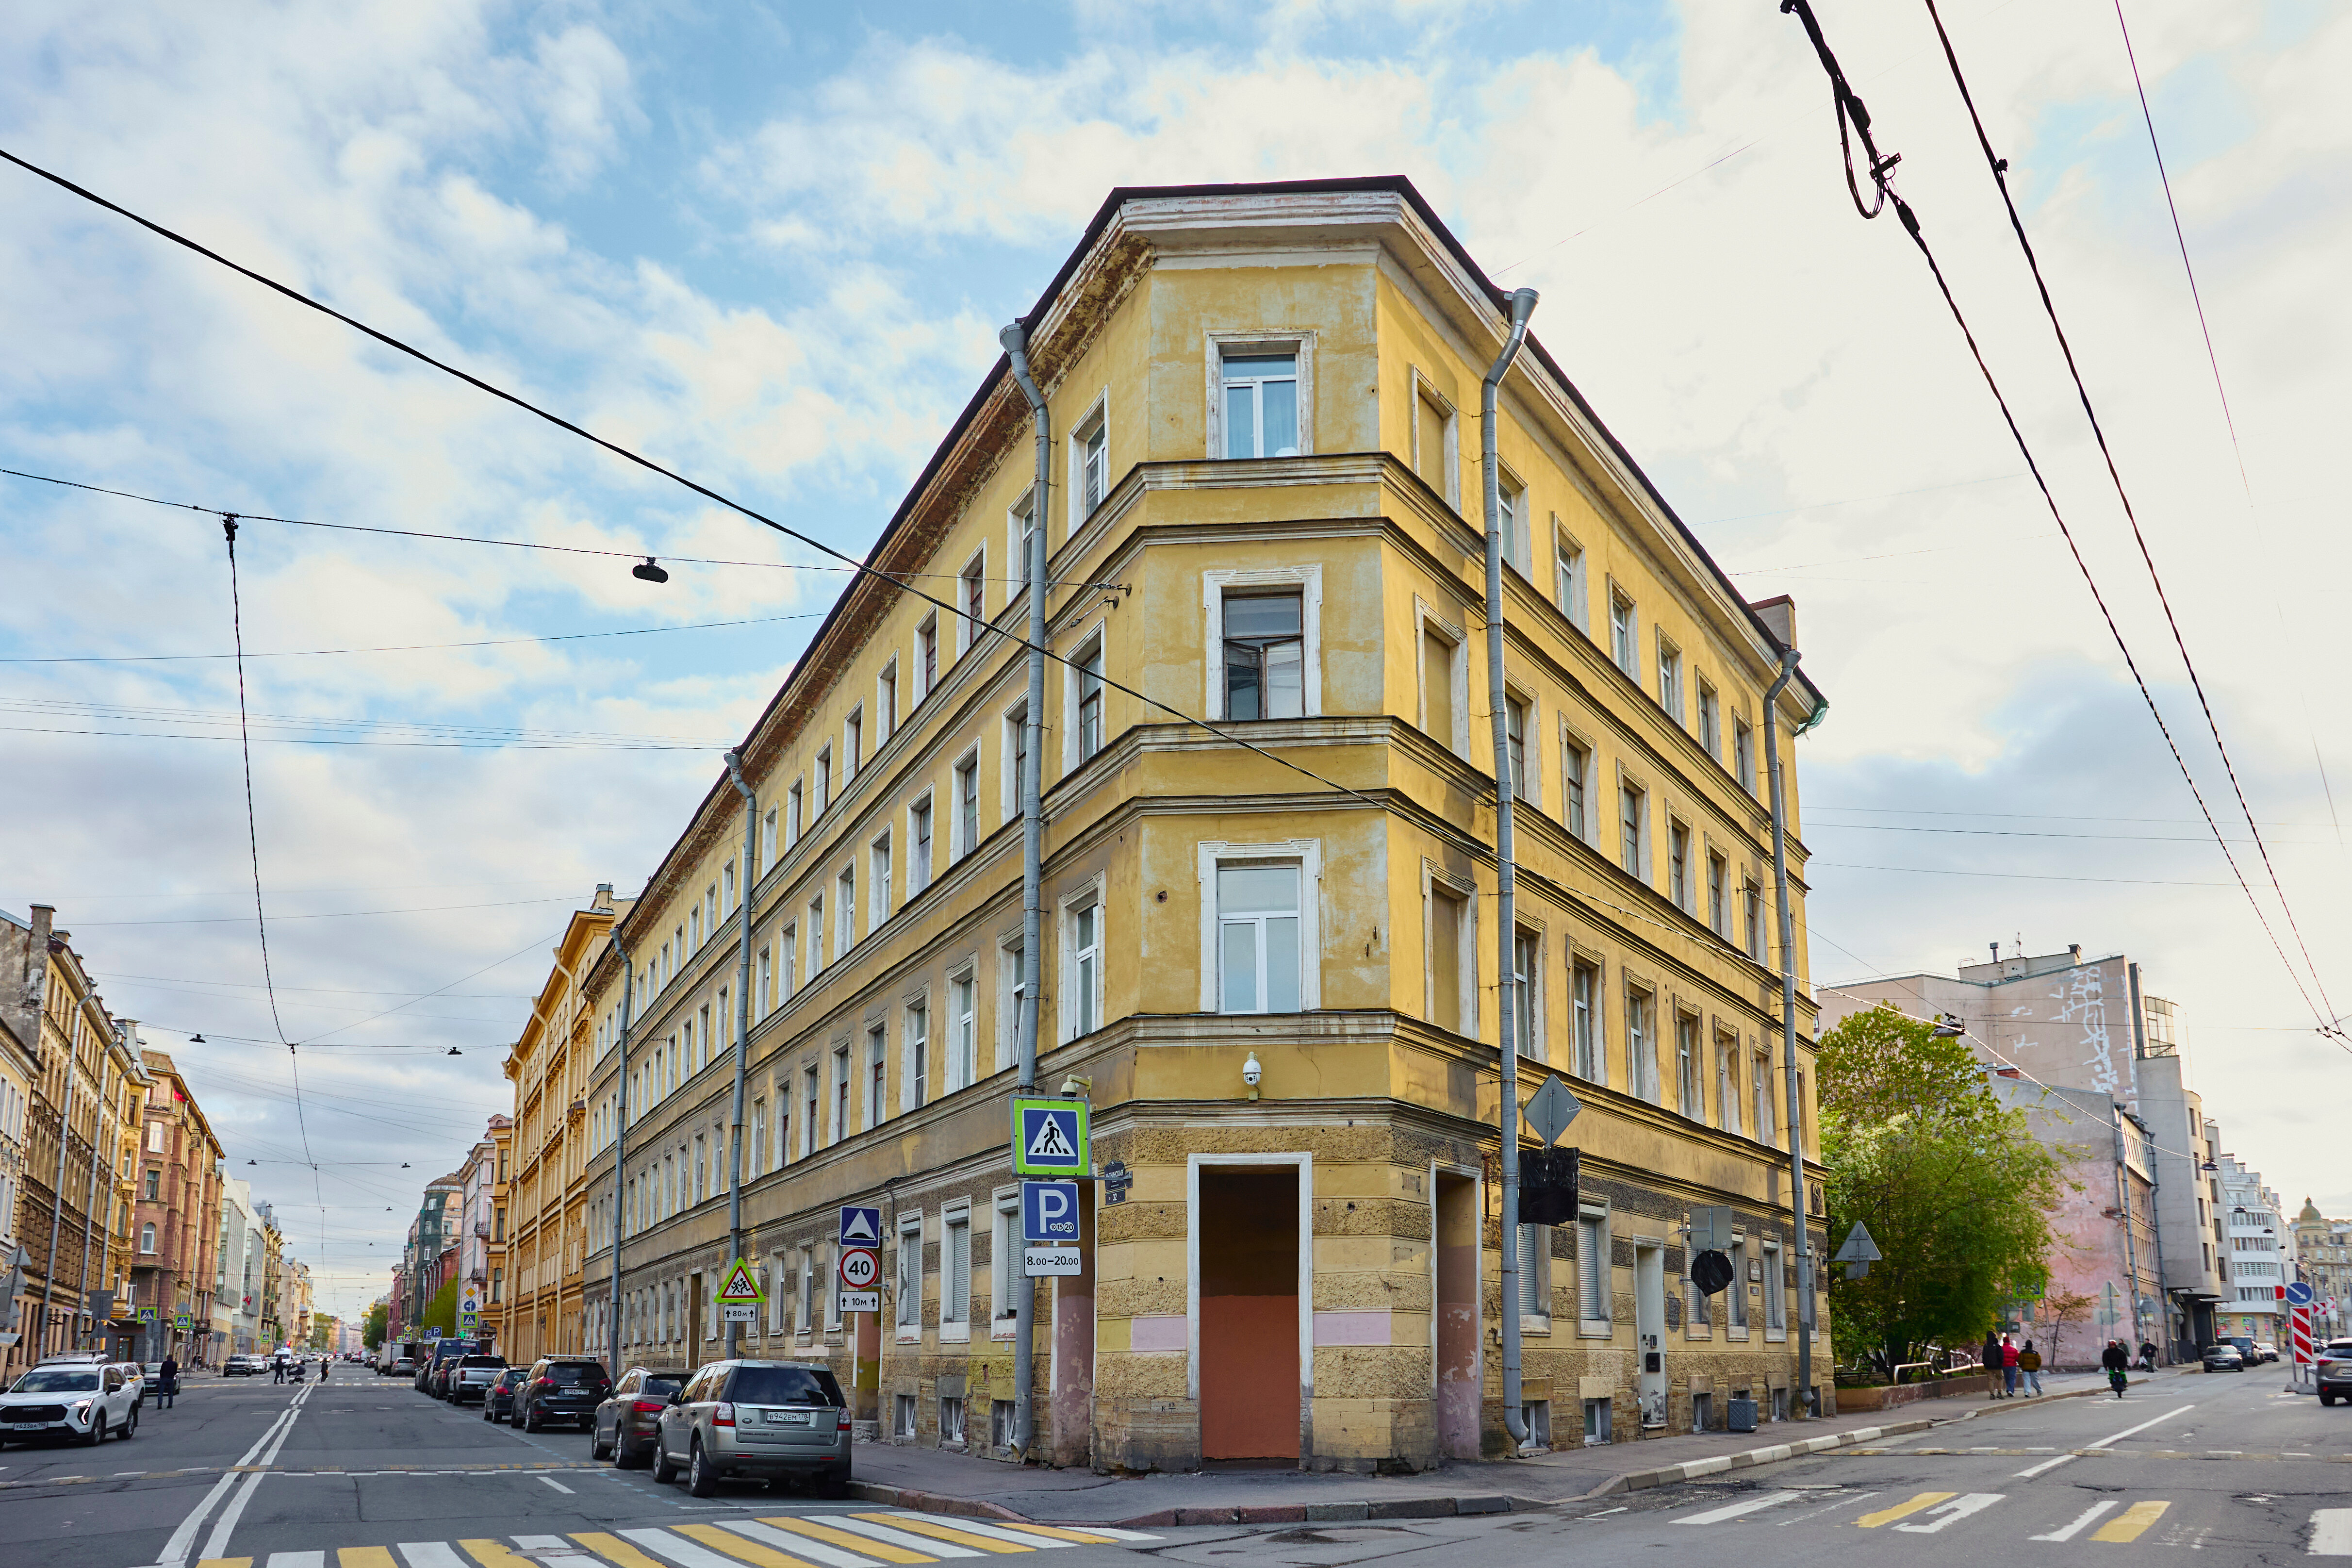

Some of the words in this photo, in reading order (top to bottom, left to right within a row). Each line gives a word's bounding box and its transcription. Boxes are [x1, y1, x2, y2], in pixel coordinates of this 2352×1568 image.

[1113, 1193, 1117, 1201] 32
[1039, 1189, 1068, 1234] P
[848, 1260, 870, 1276] 40
